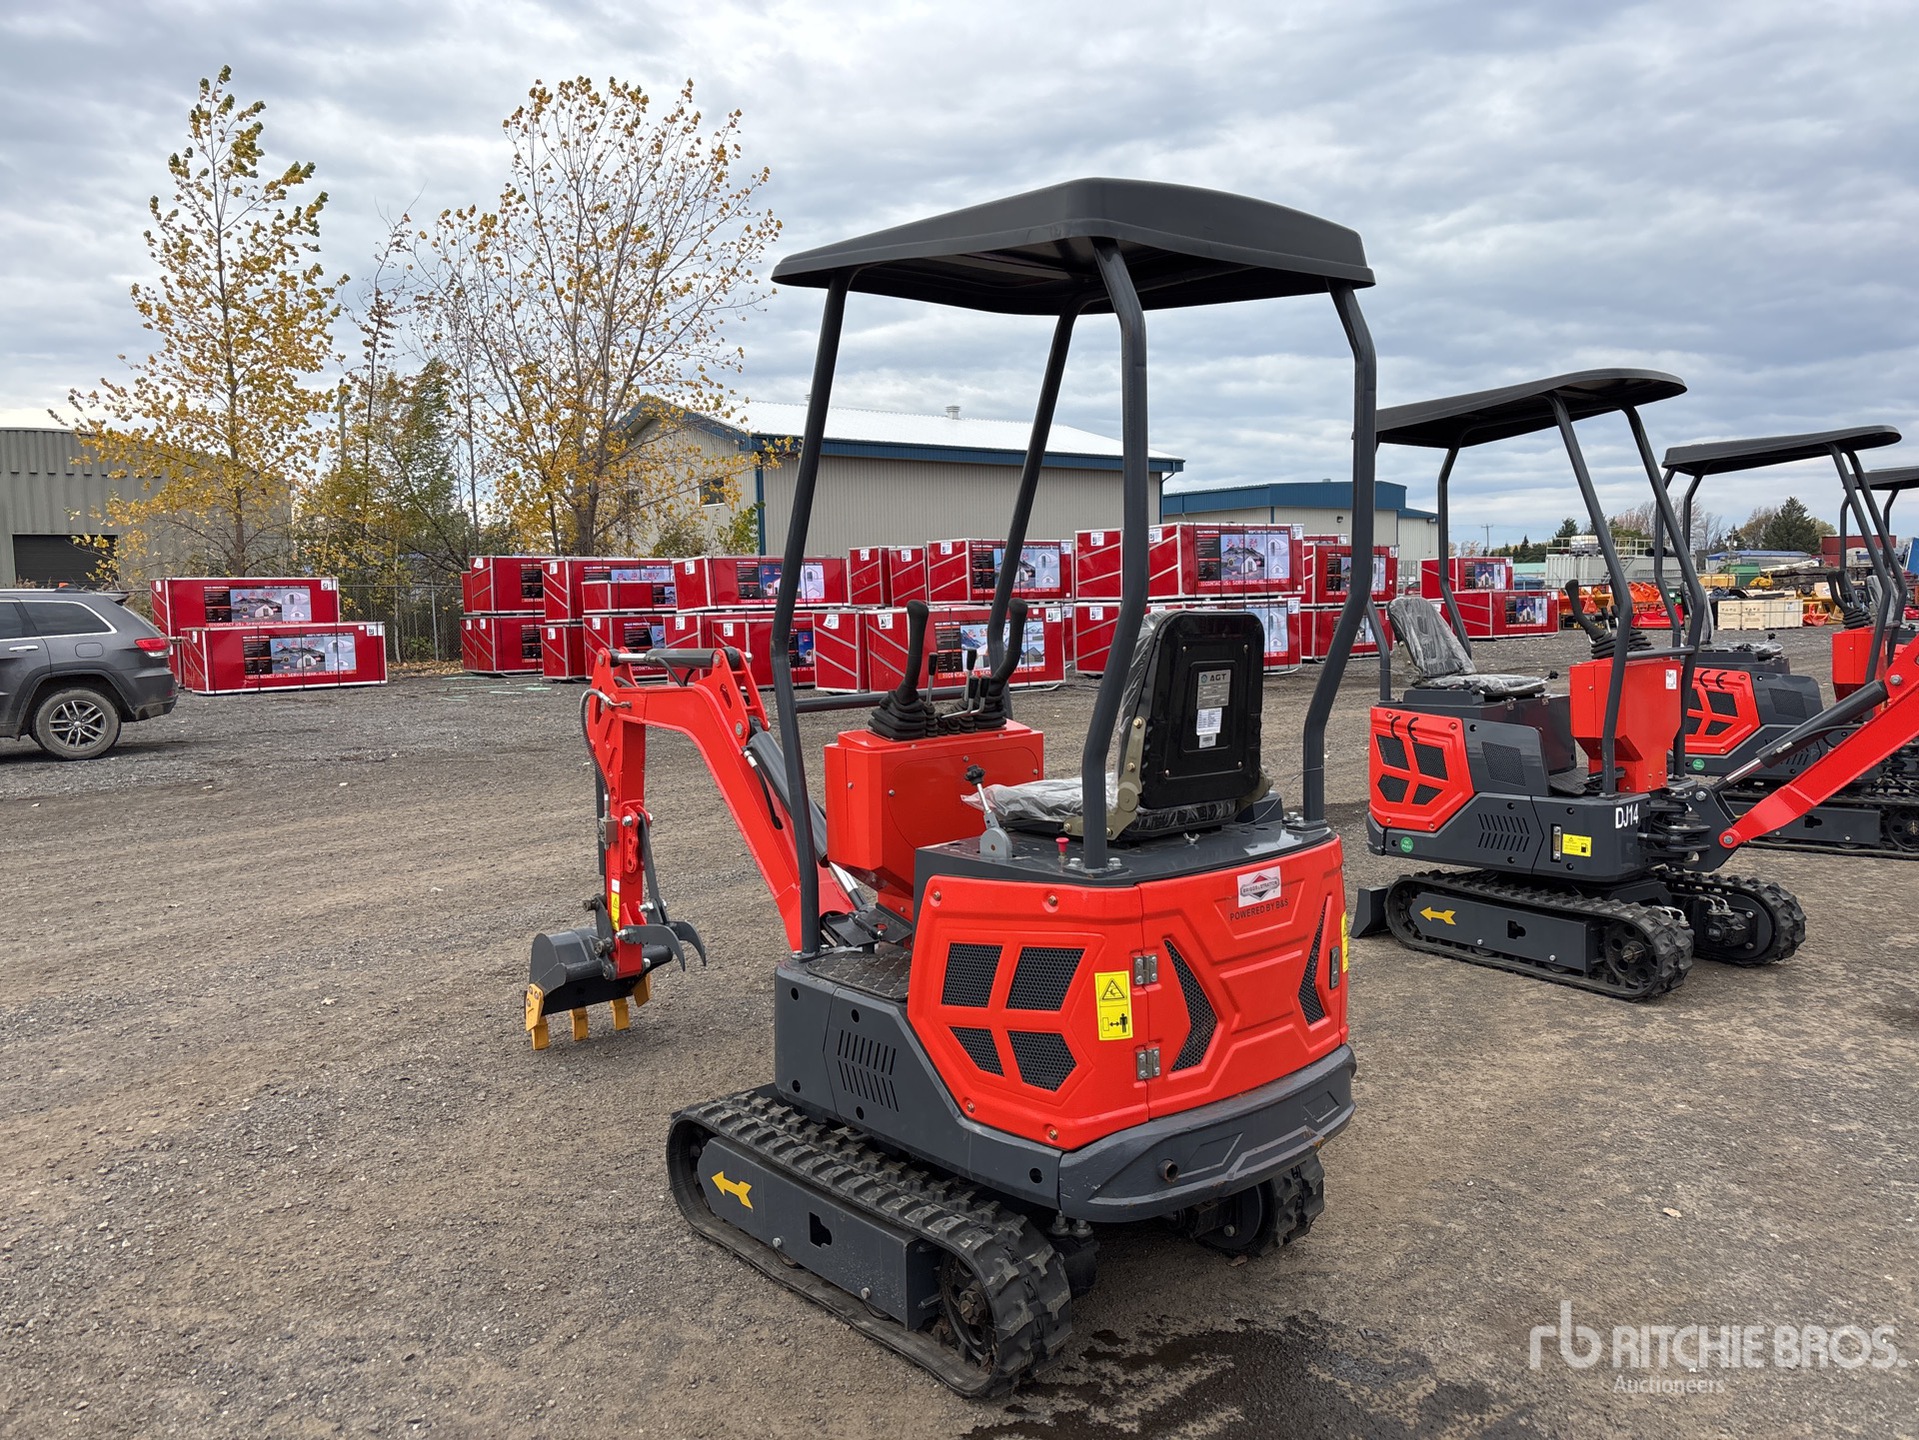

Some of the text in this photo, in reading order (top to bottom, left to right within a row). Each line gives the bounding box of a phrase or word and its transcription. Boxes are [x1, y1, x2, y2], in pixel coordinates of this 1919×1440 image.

[1210, 673, 1226, 682] AGT
[1615, 803, 1639, 829] DJ14
[1229, 899, 1289, 921] POWERED BY B&S
